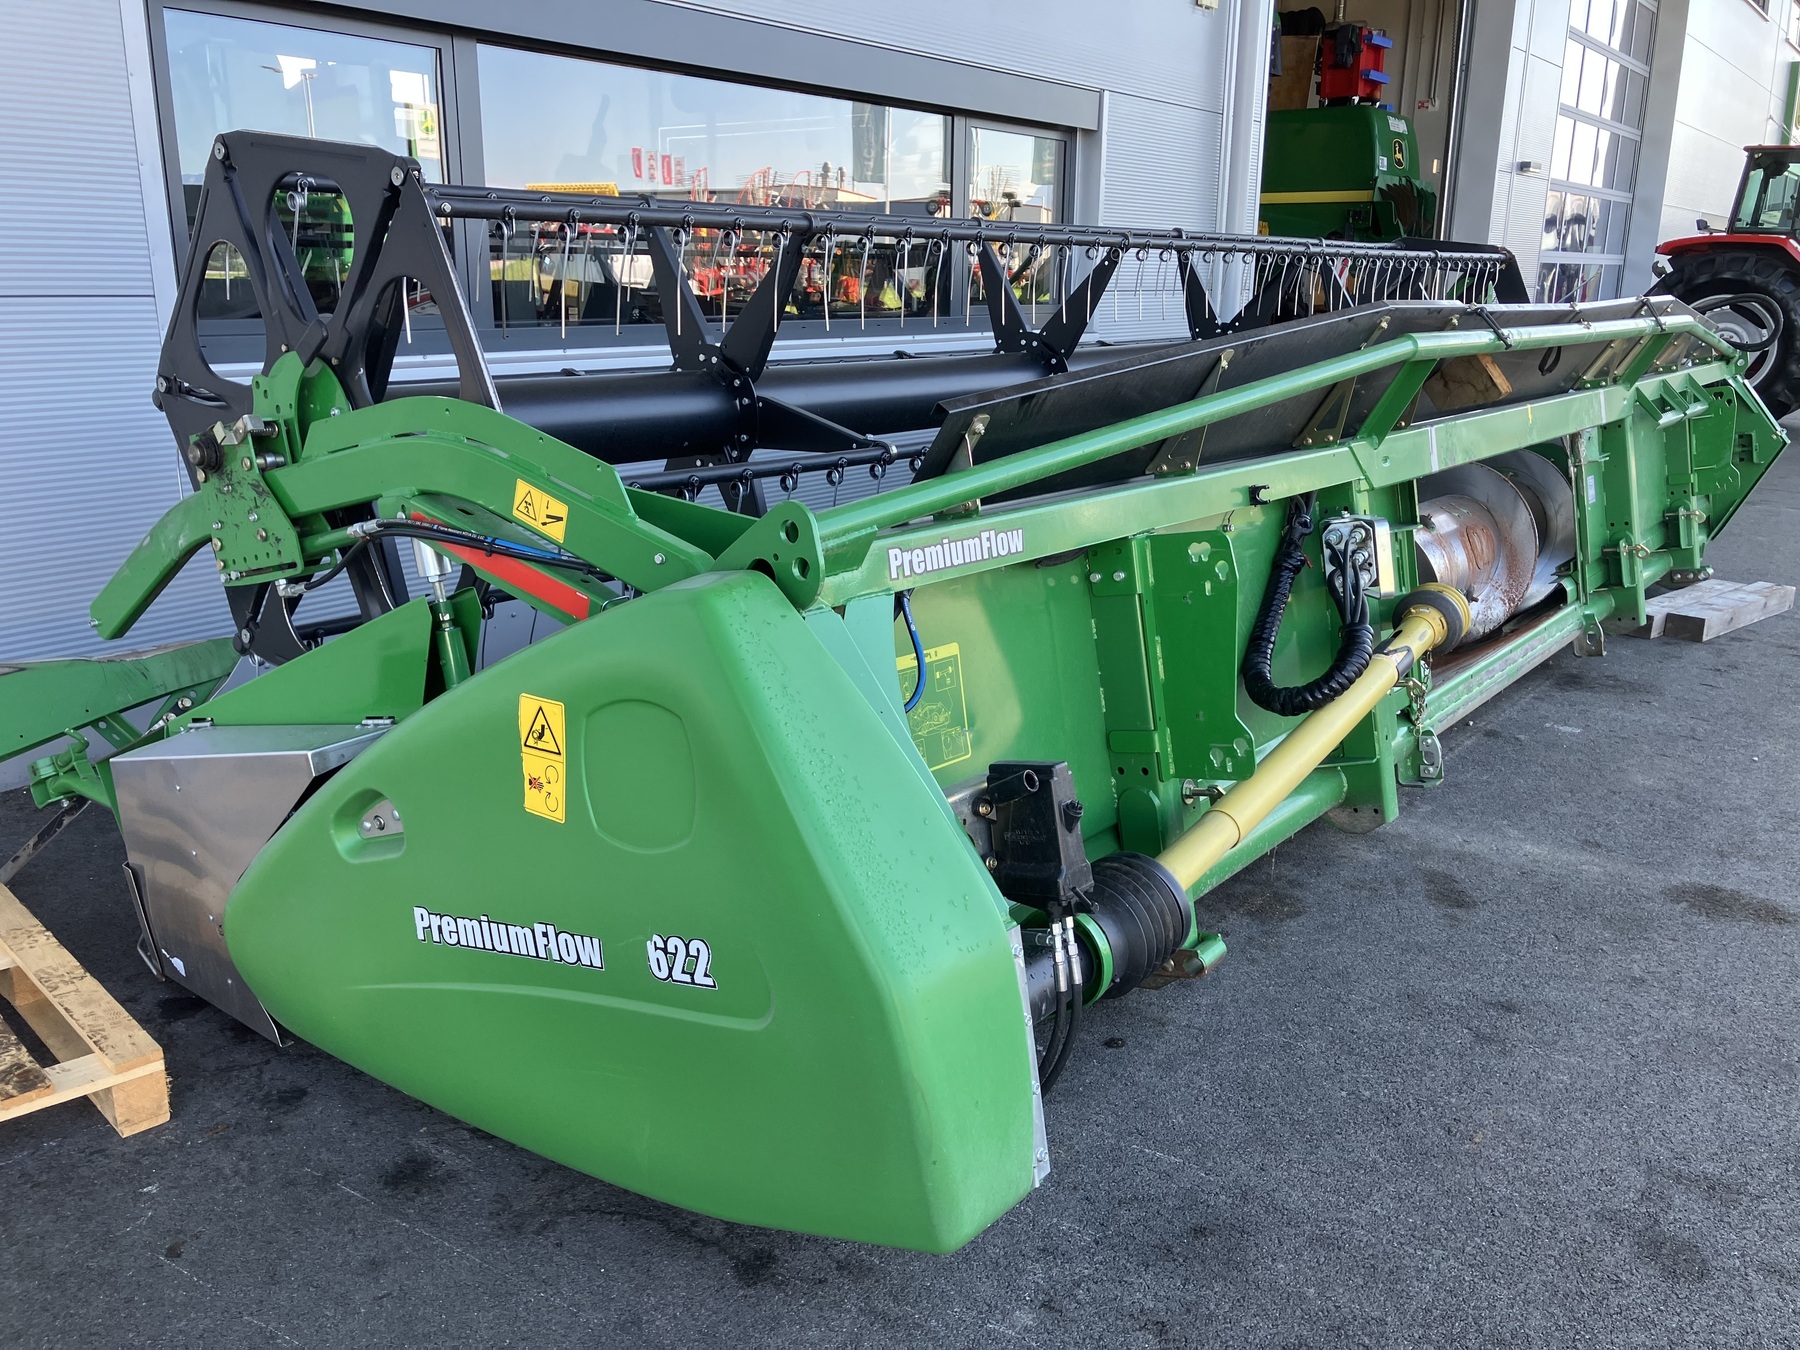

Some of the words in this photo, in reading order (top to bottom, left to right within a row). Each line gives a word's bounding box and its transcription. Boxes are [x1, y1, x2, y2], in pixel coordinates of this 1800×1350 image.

[888, 528, 1024, 581] PremiumFlow
[413, 906, 605, 970] PremiumFlow
[647, 934, 718, 989] 622
